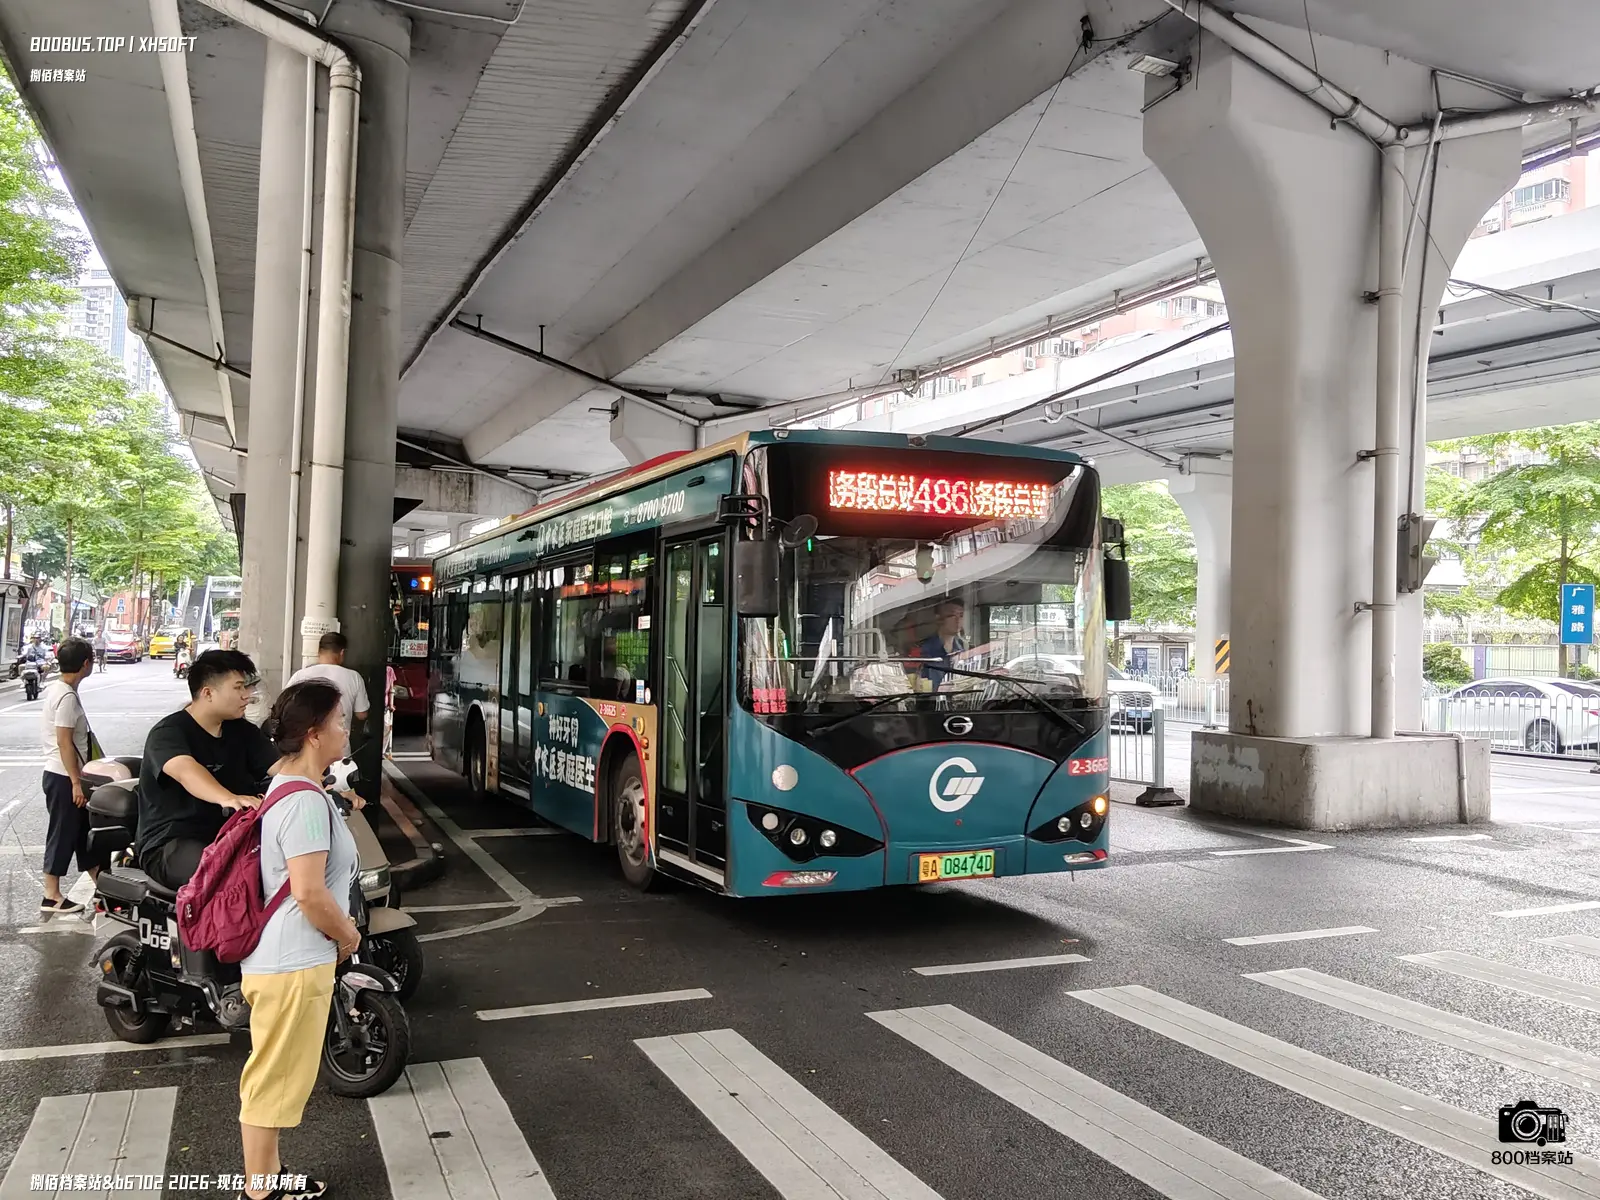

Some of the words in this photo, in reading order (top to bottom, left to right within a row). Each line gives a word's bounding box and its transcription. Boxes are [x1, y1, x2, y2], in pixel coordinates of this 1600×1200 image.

[912, 477, 969, 515] 486
[1570, 586, 1586, 633] 广雅路
